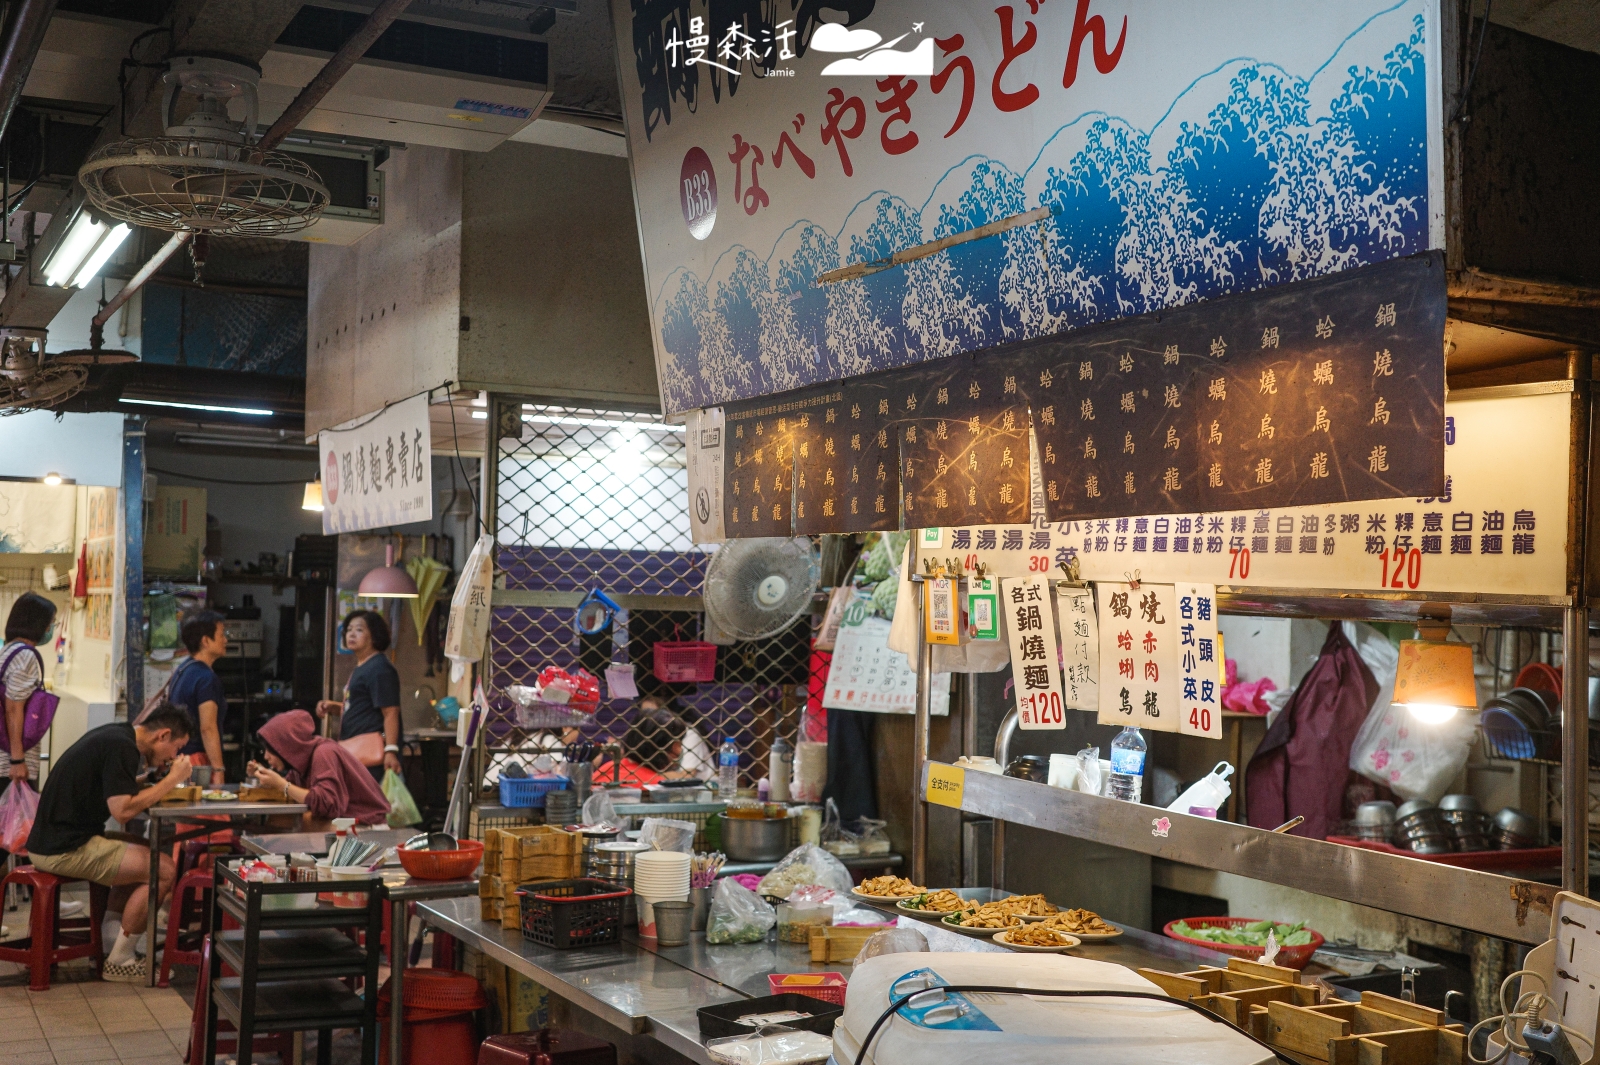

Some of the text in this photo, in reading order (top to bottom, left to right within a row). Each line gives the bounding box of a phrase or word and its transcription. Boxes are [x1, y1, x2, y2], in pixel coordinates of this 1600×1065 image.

[727, 0, 1128, 216] なべやきうどん
[684, 169, 712, 222] B33
[342, 428, 423, 496] 鍋燒麵專賣店
[926, 530, 938, 540] Pay
[952, 530, 972, 550] 湯
[976, 530, 997, 550] 湯
[1002, 530, 1024, 550] 湯
[1094, 519, 1110, 552] 米粉
[1132, 517, 1150, 552] 意麵
[1152, 517, 1170, 552] 白麵
[1173, 516, 1192, 552] 油麵
[1206, 516, 1224, 553] 米粉
[1252, 516, 1270, 554] 意麵
[1274, 514, 1294, 554] 白麵
[1299, 514, 1319, 554] 油麵
[1340, 514, 1360, 533] 粥
[1366, 513, 1387, 554] 米粉
[1421, 512, 1444, 554] 意麵
[1450, 511, 1472, 554] 白麵
[1480, 510, 1504, 554] 油麵
[1512, 509, 1536, 554] 烏龍
[964, 554, 978, 571] 40
[1028, 556, 1050, 572] 30
[1228, 548, 1250, 580] 70
[1379, 547, 1422, 590] 120
[470, 590, 486, 608] 紙
[1011, 584, 1042, 604] 各式
[1109, 591, 1166, 624] 鍋燒
[846, 606, 865, 622] 10
[1016, 605, 1050, 690] 鍋燒麵
[1142, 630, 1160, 682] 赤肉
[1180, 596, 1198, 700] 各式小菜
[1197, 596, 1215, 704] 豬頭皮
[1029, 692, 1062, 724] 120
[1190, 707, 1211, 732] 40
[932, 778, 949, 792] 全支付
